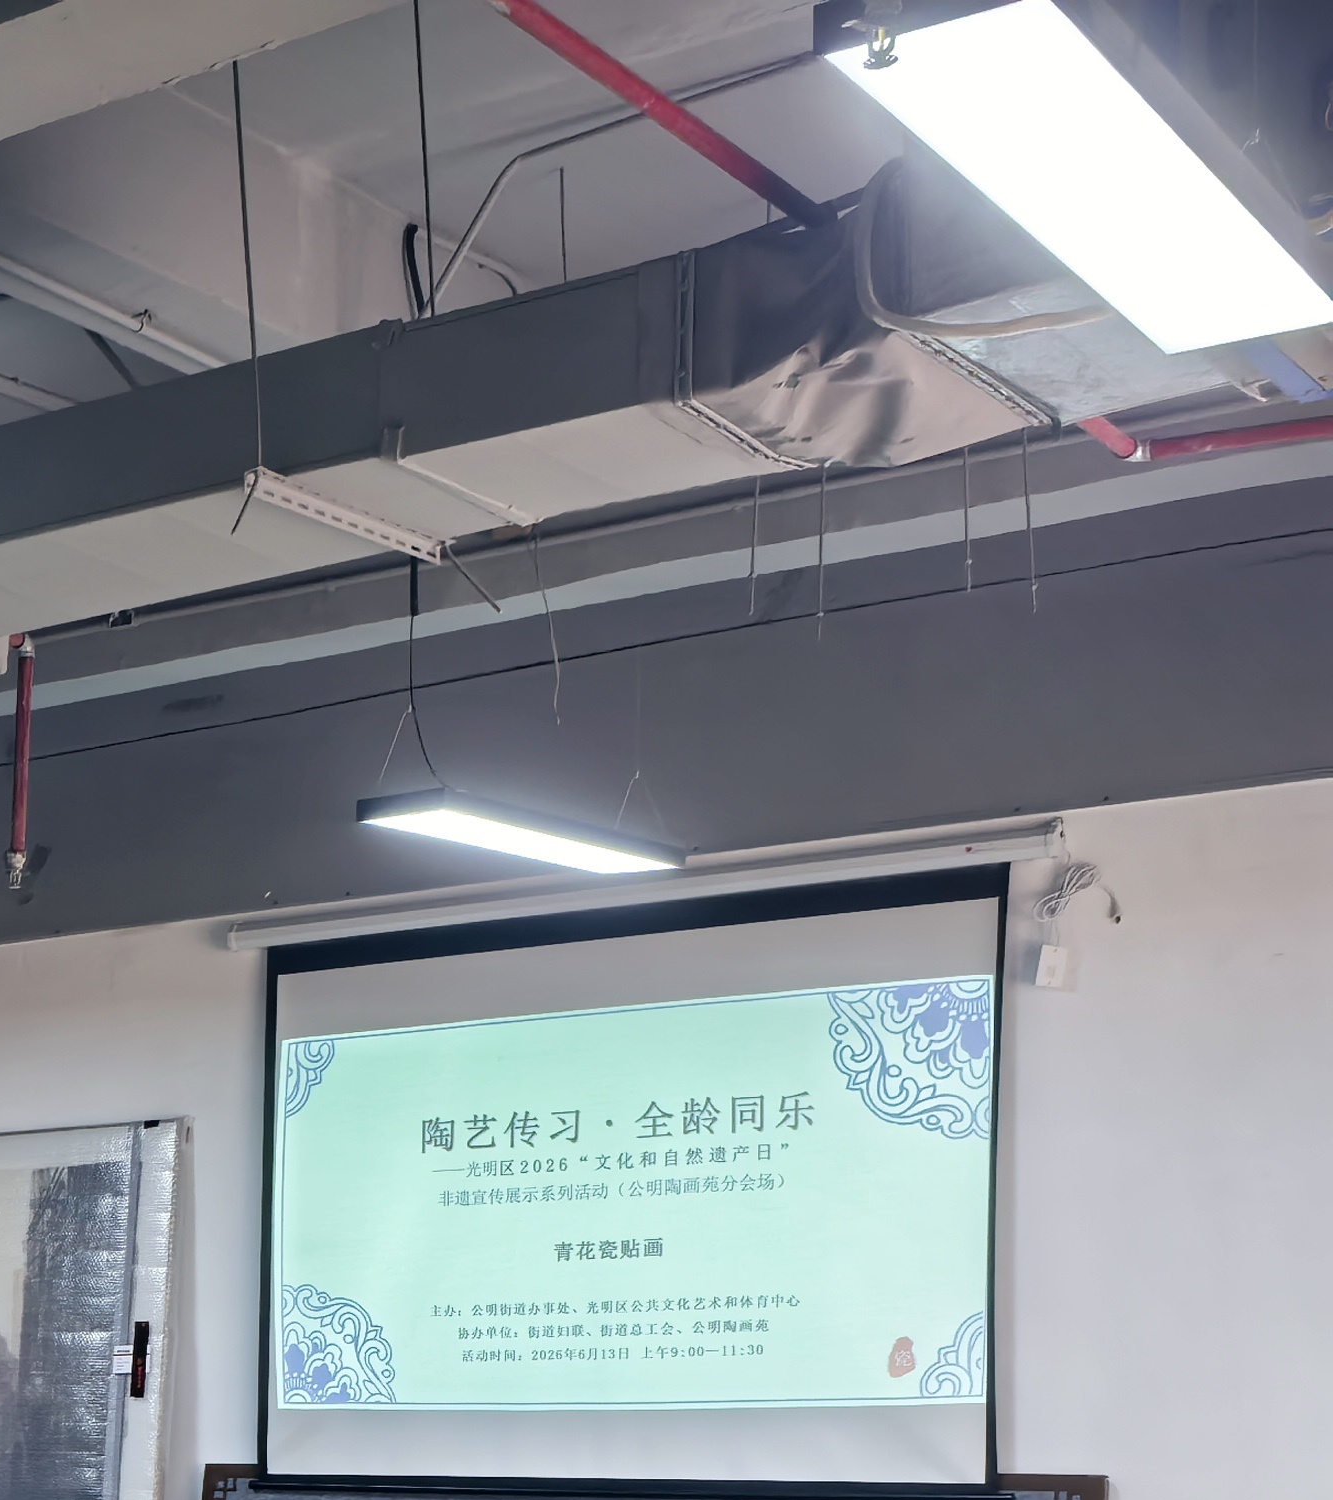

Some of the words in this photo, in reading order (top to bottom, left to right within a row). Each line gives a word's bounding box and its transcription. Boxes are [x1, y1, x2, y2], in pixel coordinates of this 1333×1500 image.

[421, 1091, 814, 1153] 陶艺传习·全龄同乐
[553, 1236, 664, 1262] 青花瓷贴画
